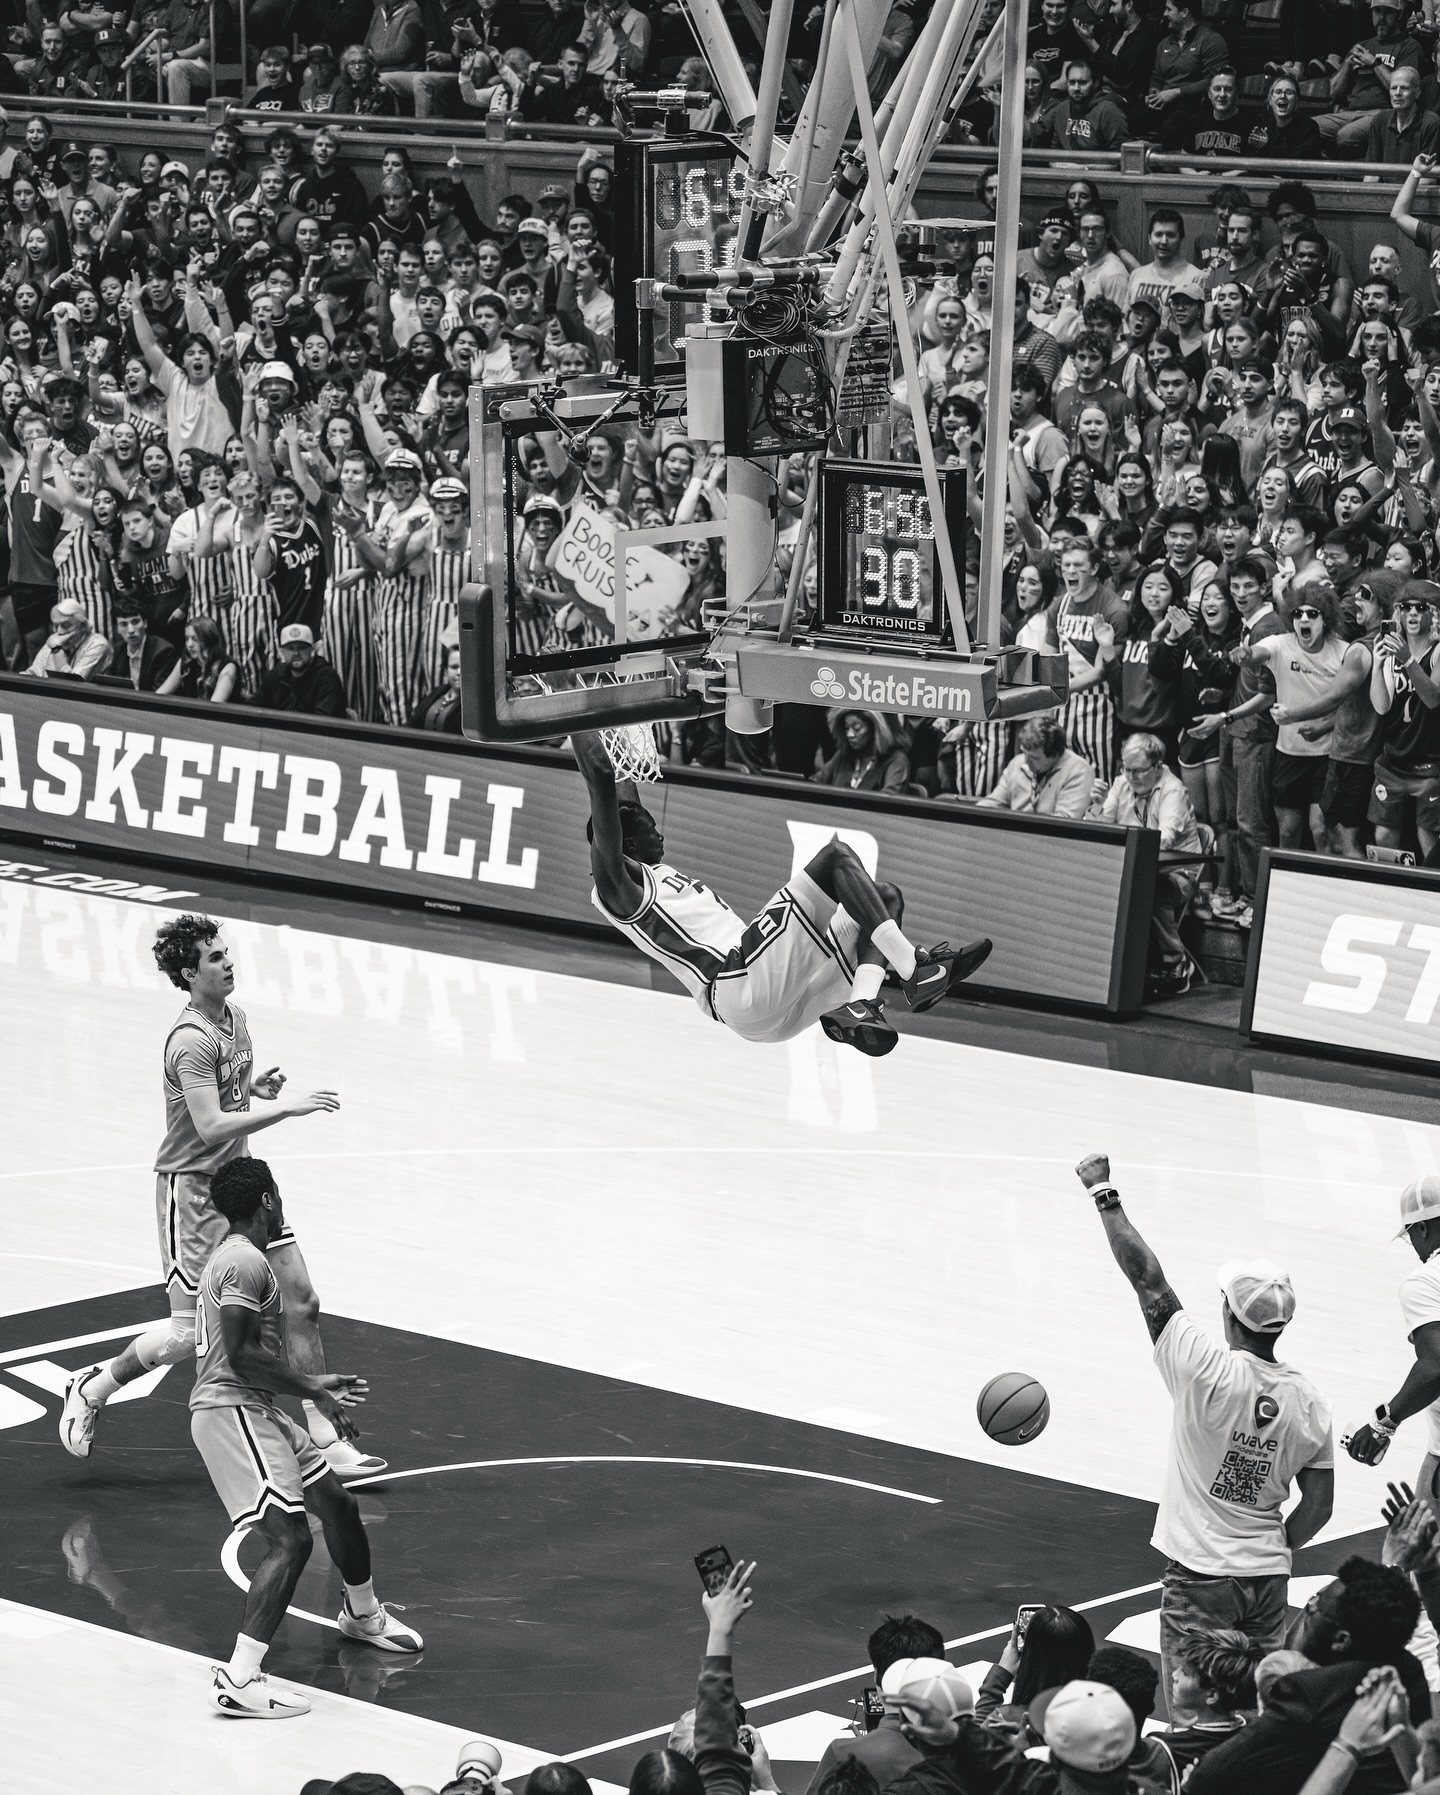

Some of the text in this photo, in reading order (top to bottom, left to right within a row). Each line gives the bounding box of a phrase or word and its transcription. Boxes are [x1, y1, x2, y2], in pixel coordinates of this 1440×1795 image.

[32, 497, 42, 523] 1
[281, 542, 321, 570] Duke
[304, 566, 313, 590] 1
[842, 613, 926, 633] DAKTRONICS
[1232, 1430, 1278, 1452] wave
[1233, 1444, 1269, 1459] rideshare
